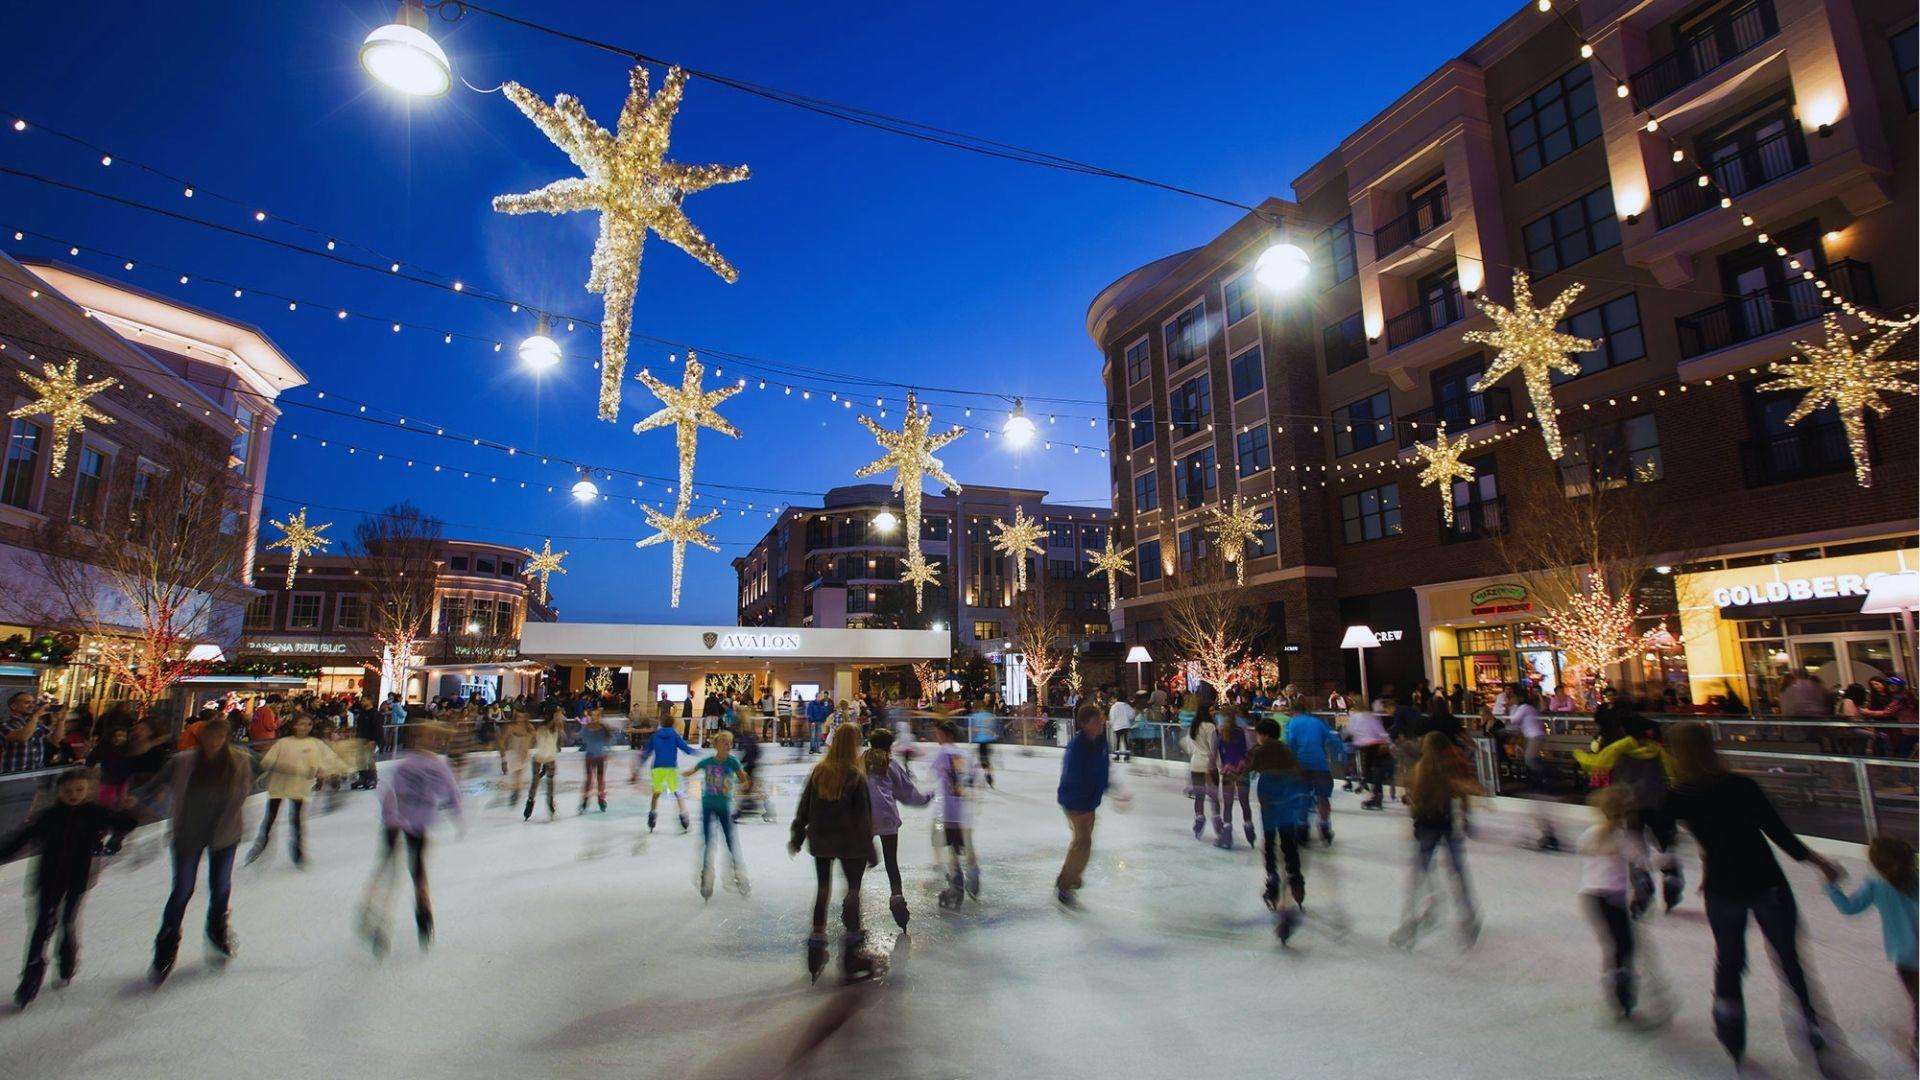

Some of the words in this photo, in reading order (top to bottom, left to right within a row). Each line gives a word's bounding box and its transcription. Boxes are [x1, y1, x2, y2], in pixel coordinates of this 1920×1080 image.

[1374, 630, 1403, 641] CREW
[723, 635, 798, 648] AVALON
[294, 643, 347, 653] REPUBLIC
